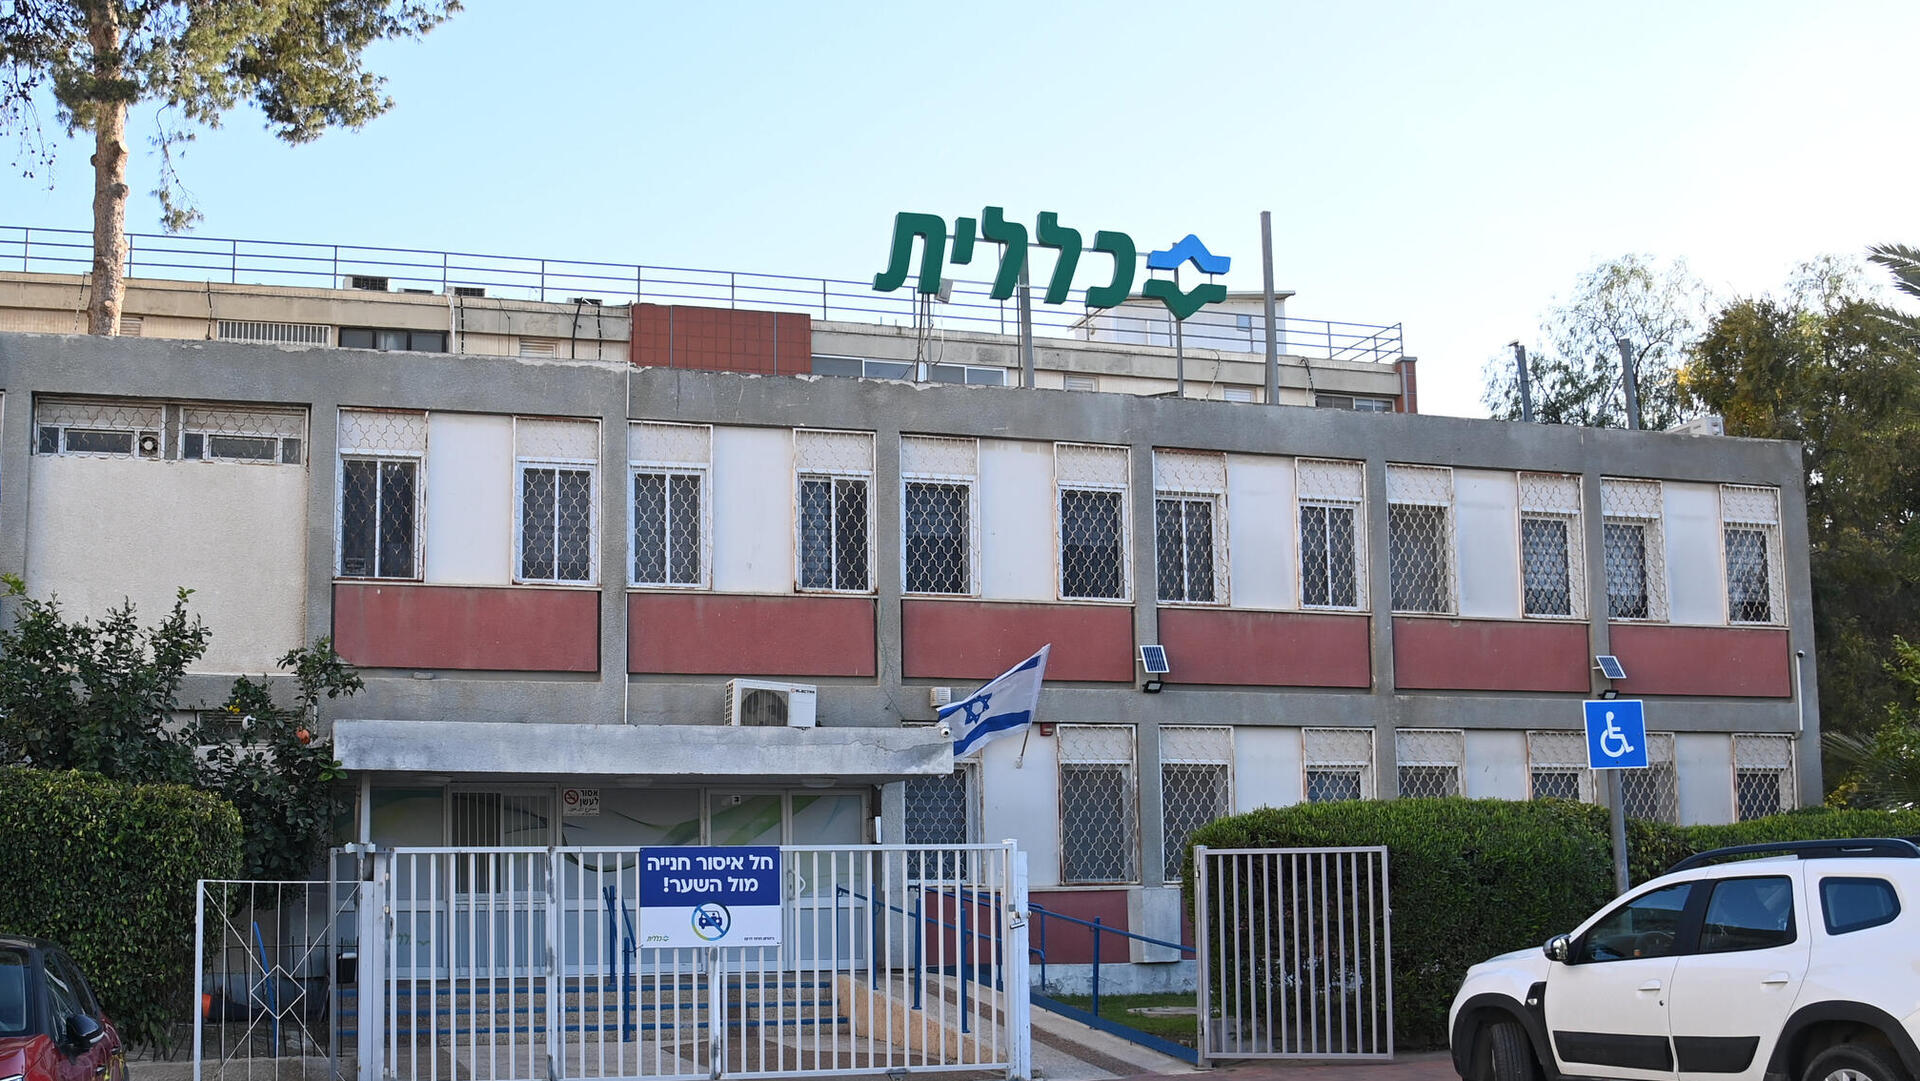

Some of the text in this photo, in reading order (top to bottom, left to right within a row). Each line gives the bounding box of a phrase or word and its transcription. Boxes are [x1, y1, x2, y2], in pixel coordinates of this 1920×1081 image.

[872, 206, 1136, 309] כללית
[580, 797, 598, 807] לעשן
[647, 854, 774, 871] חל איסור חנייה
[663, 876, 759, 893] מול השער!
